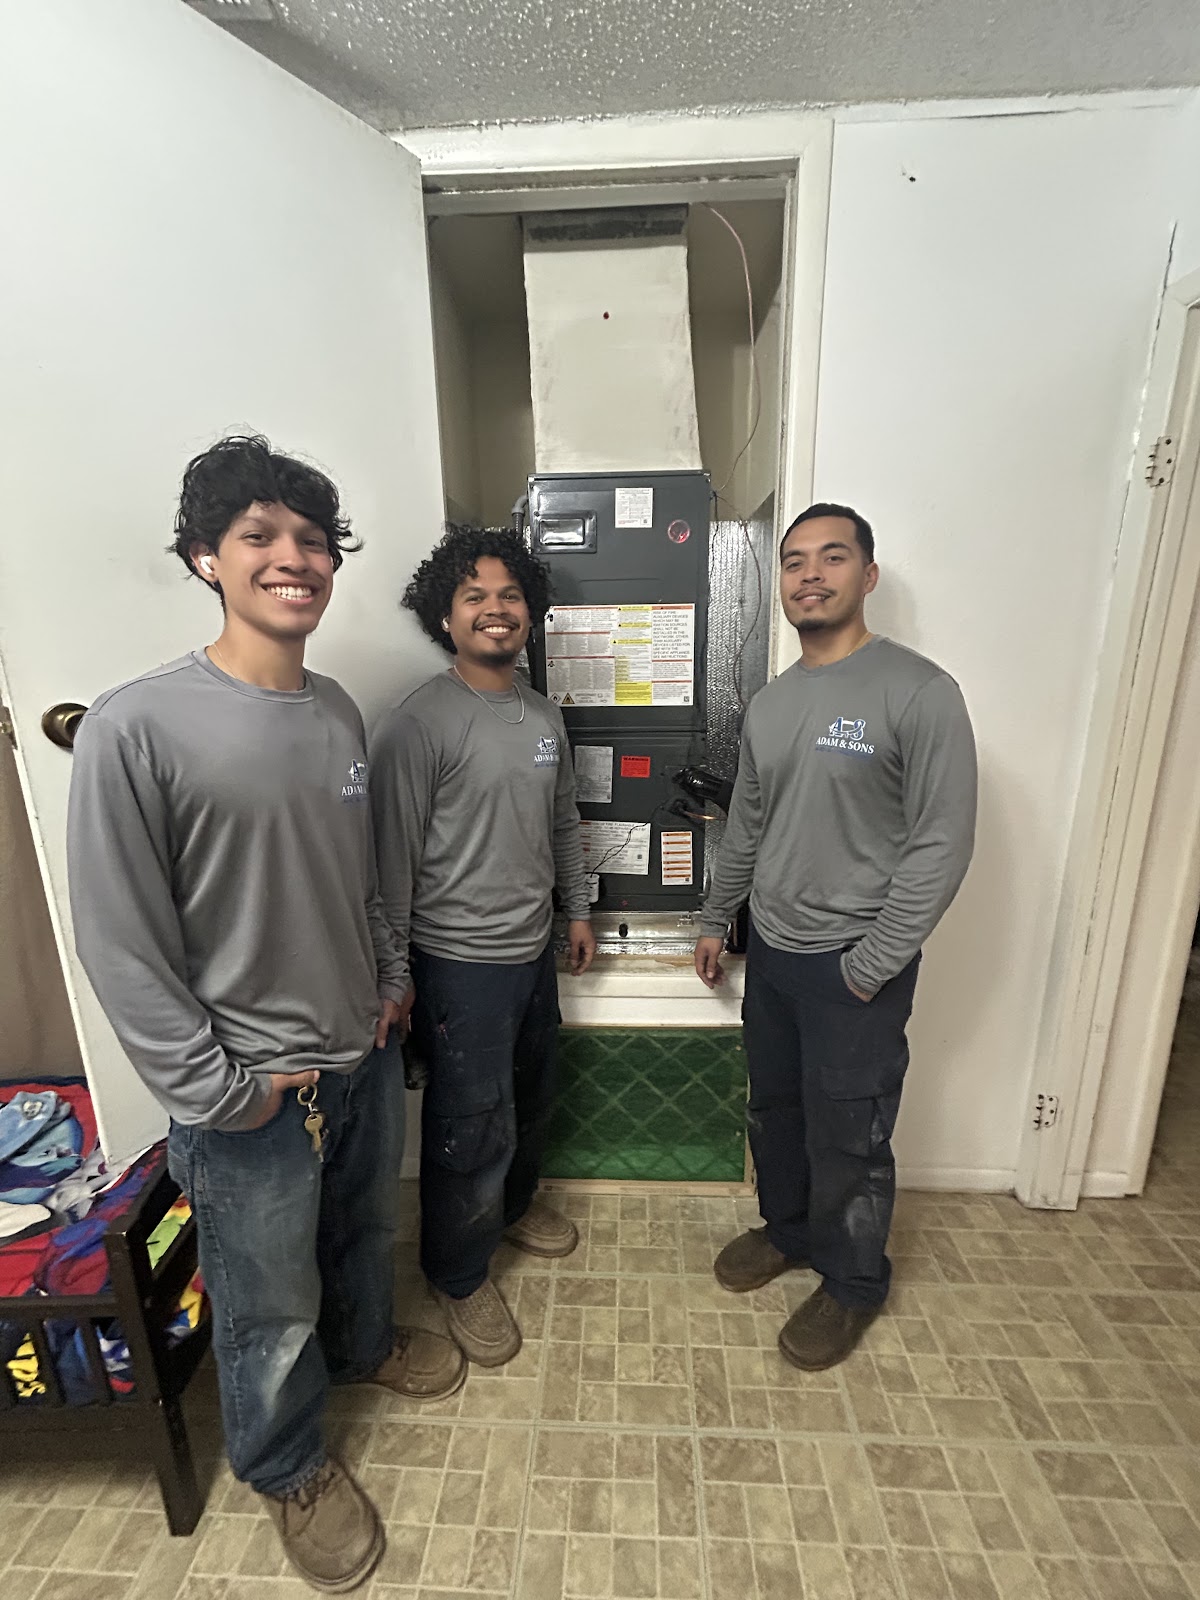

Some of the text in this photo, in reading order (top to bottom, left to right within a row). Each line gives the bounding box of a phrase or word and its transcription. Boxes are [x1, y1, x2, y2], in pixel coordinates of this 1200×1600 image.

[816, 737, 839, 747] ADAM
[839, 740, 847, 748] &
[848, 741, 874, 754] SONS
